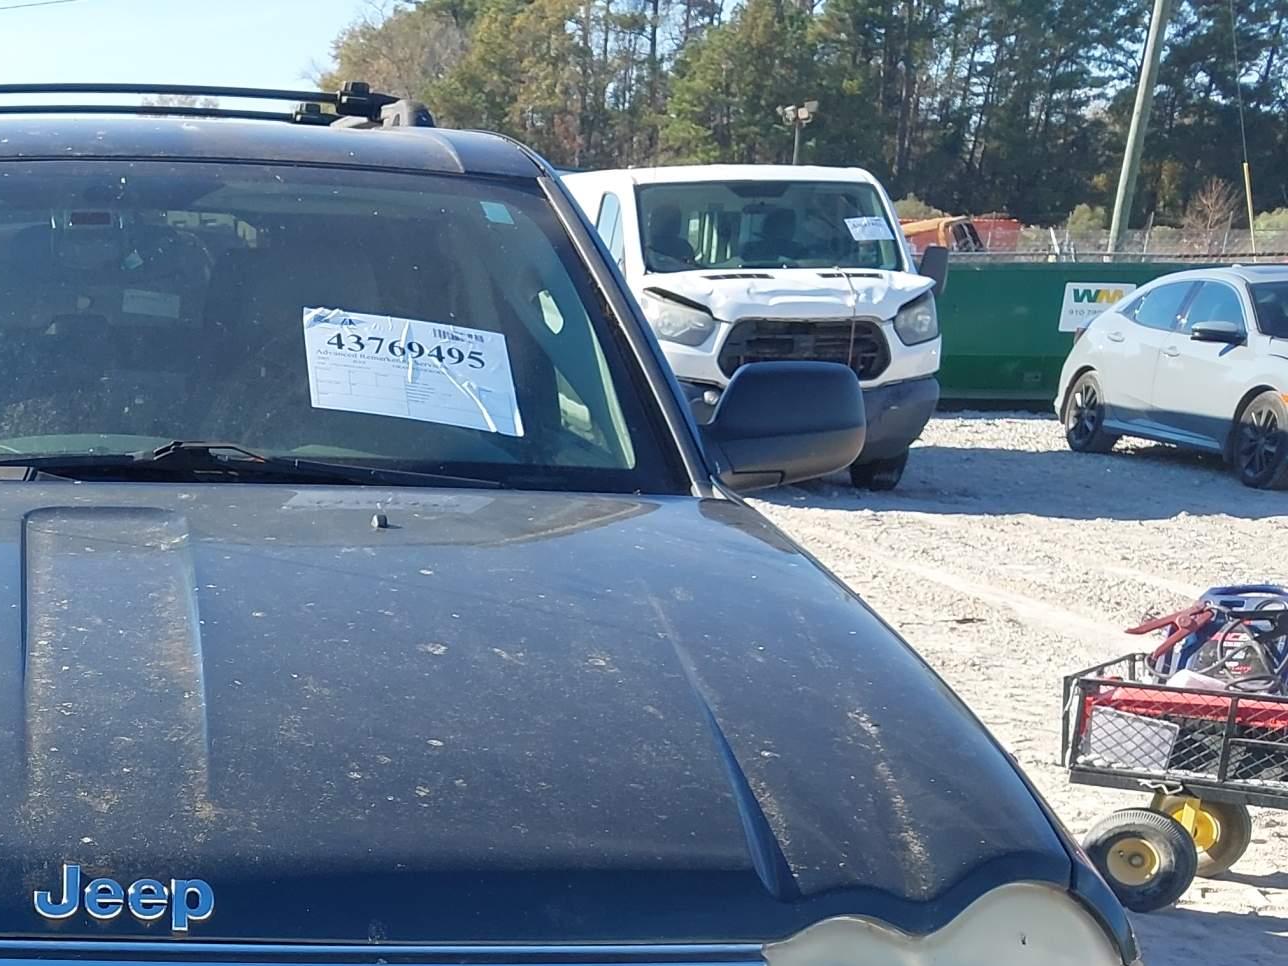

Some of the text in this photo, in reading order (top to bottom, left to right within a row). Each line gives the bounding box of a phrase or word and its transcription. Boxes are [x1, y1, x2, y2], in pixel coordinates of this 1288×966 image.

[1073, 288, 1124, 304] WM
[326, 332, 485, 369] 43769495
[33, 863, 215, 932] Jeep
